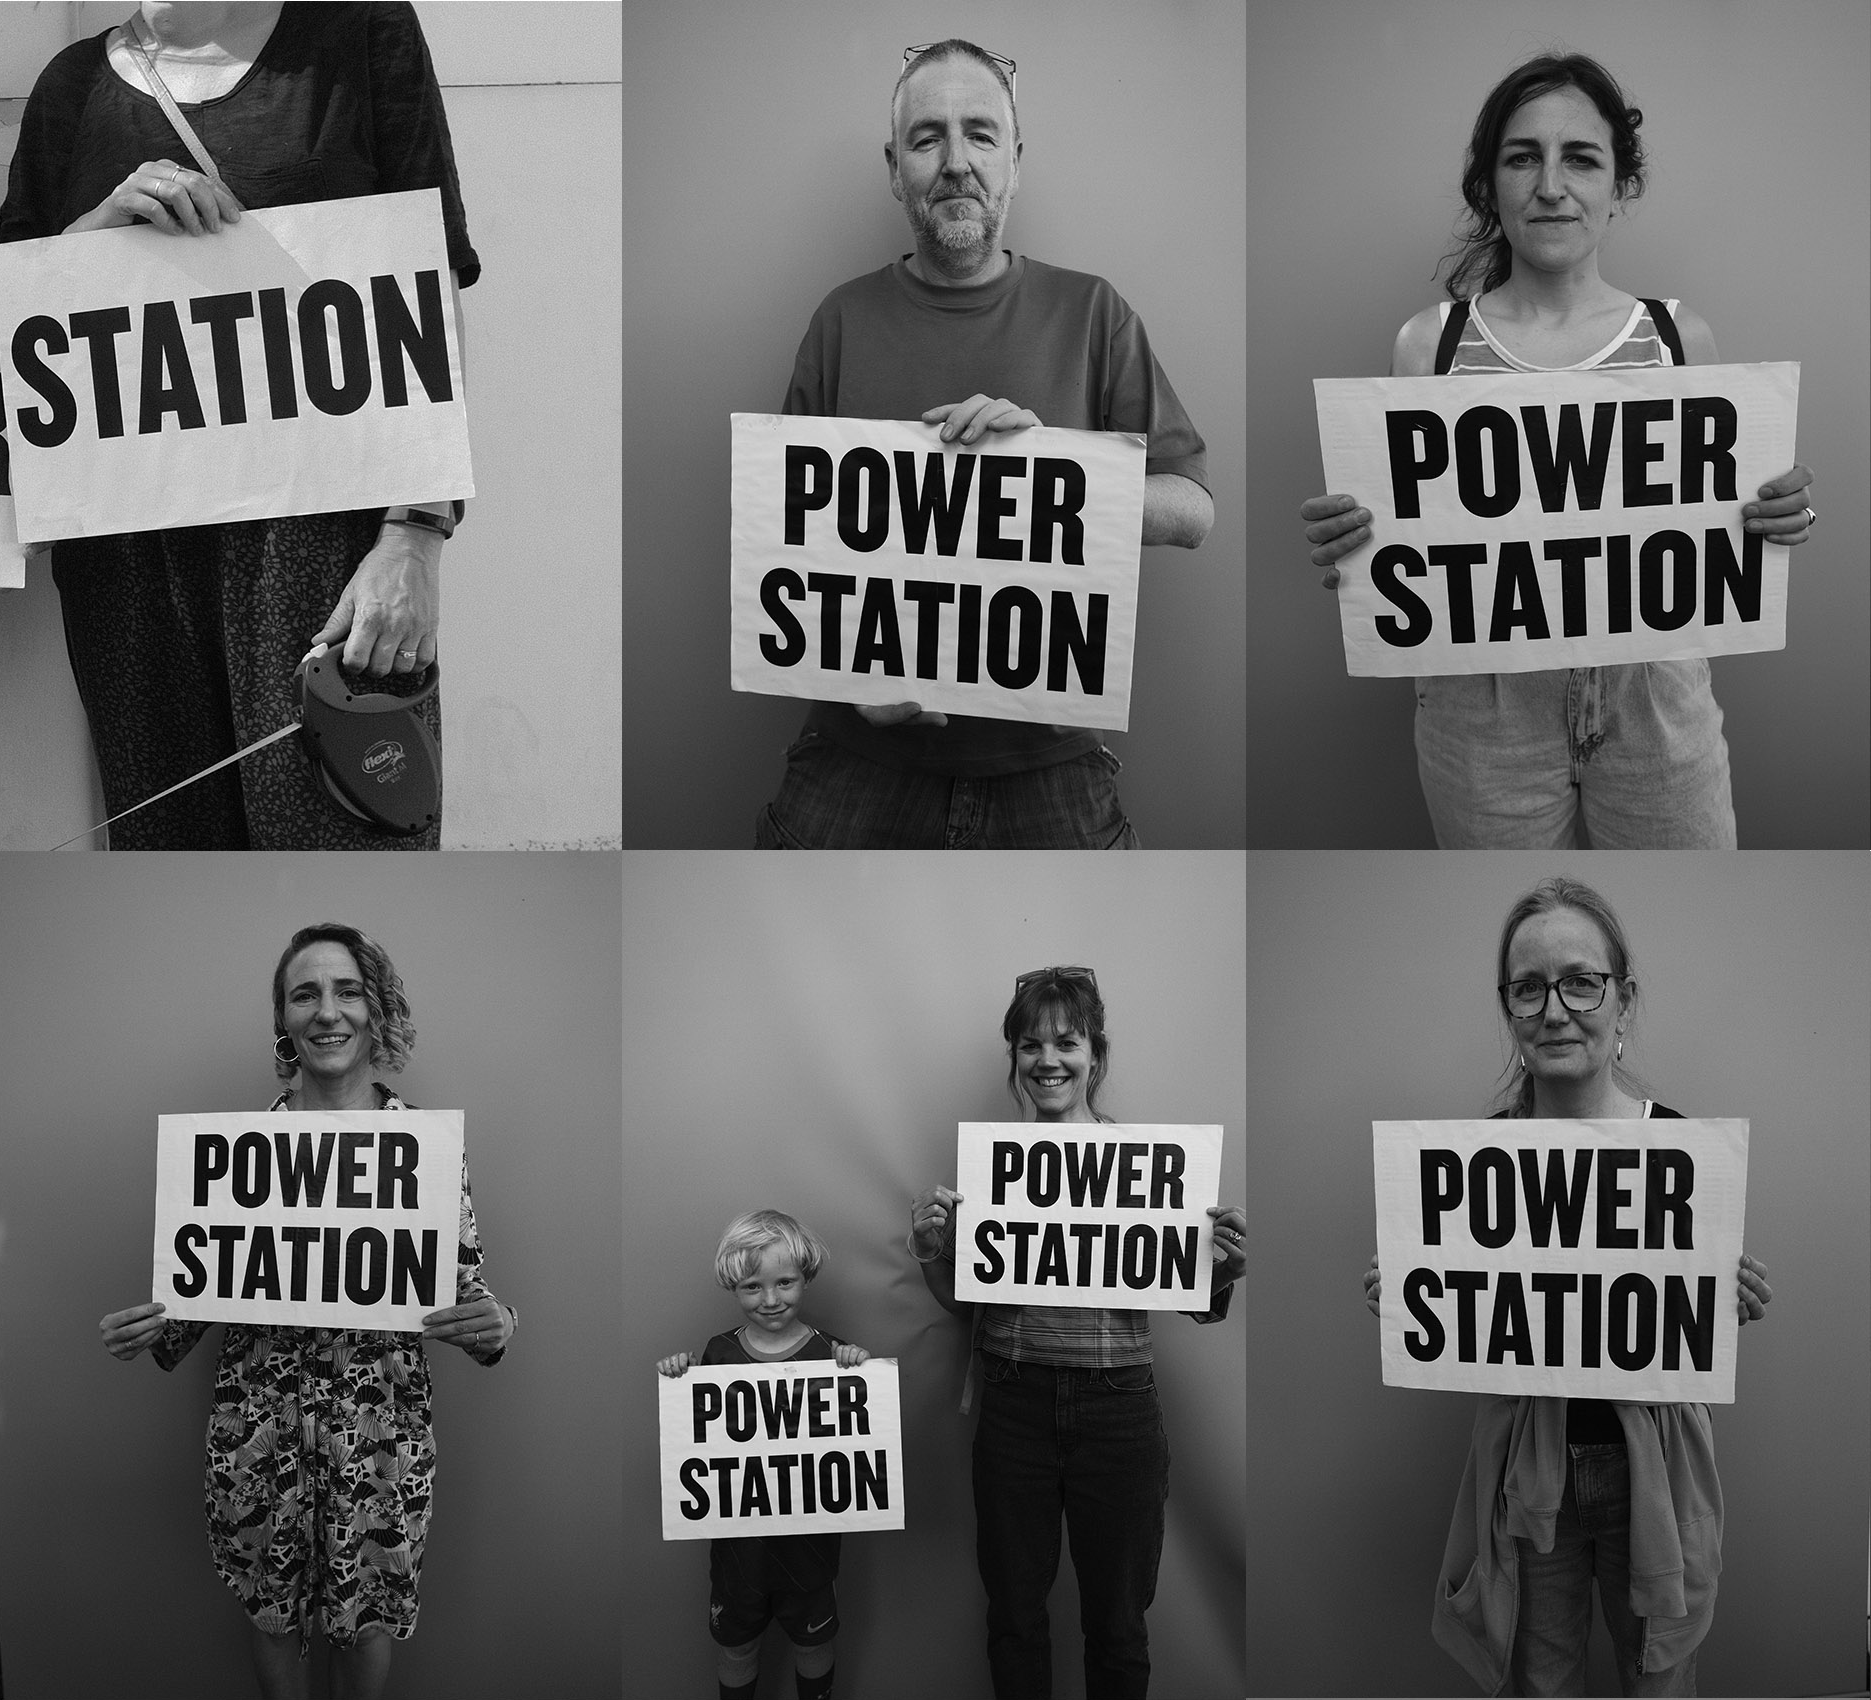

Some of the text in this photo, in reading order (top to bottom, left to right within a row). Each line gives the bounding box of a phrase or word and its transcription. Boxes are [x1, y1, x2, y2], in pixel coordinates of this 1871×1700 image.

[12, 270, 453, 448] STATION
[1386, 397, 1738, 519] POWER
[785, 445, 1086, 565] POWER
[759, 568, 1109, 695] STATION
[1371, 530, 1763, 647] STATION
[364, 745, 394, 770] flexi
[194, 1132, 419, 1209] POWER
[992, 1141, 1185, 1209] POWER
[1420, 1147, 1694, 1250] POWER
[173, 1224, 438, 1306] STATION
[974, 1220, 1198, 1290] STATION
[1403, 1268, 1716, 1371] STATION
[693, 1376, 870, 1443] POWER
[680, 1450, 888, 1520] STATION
